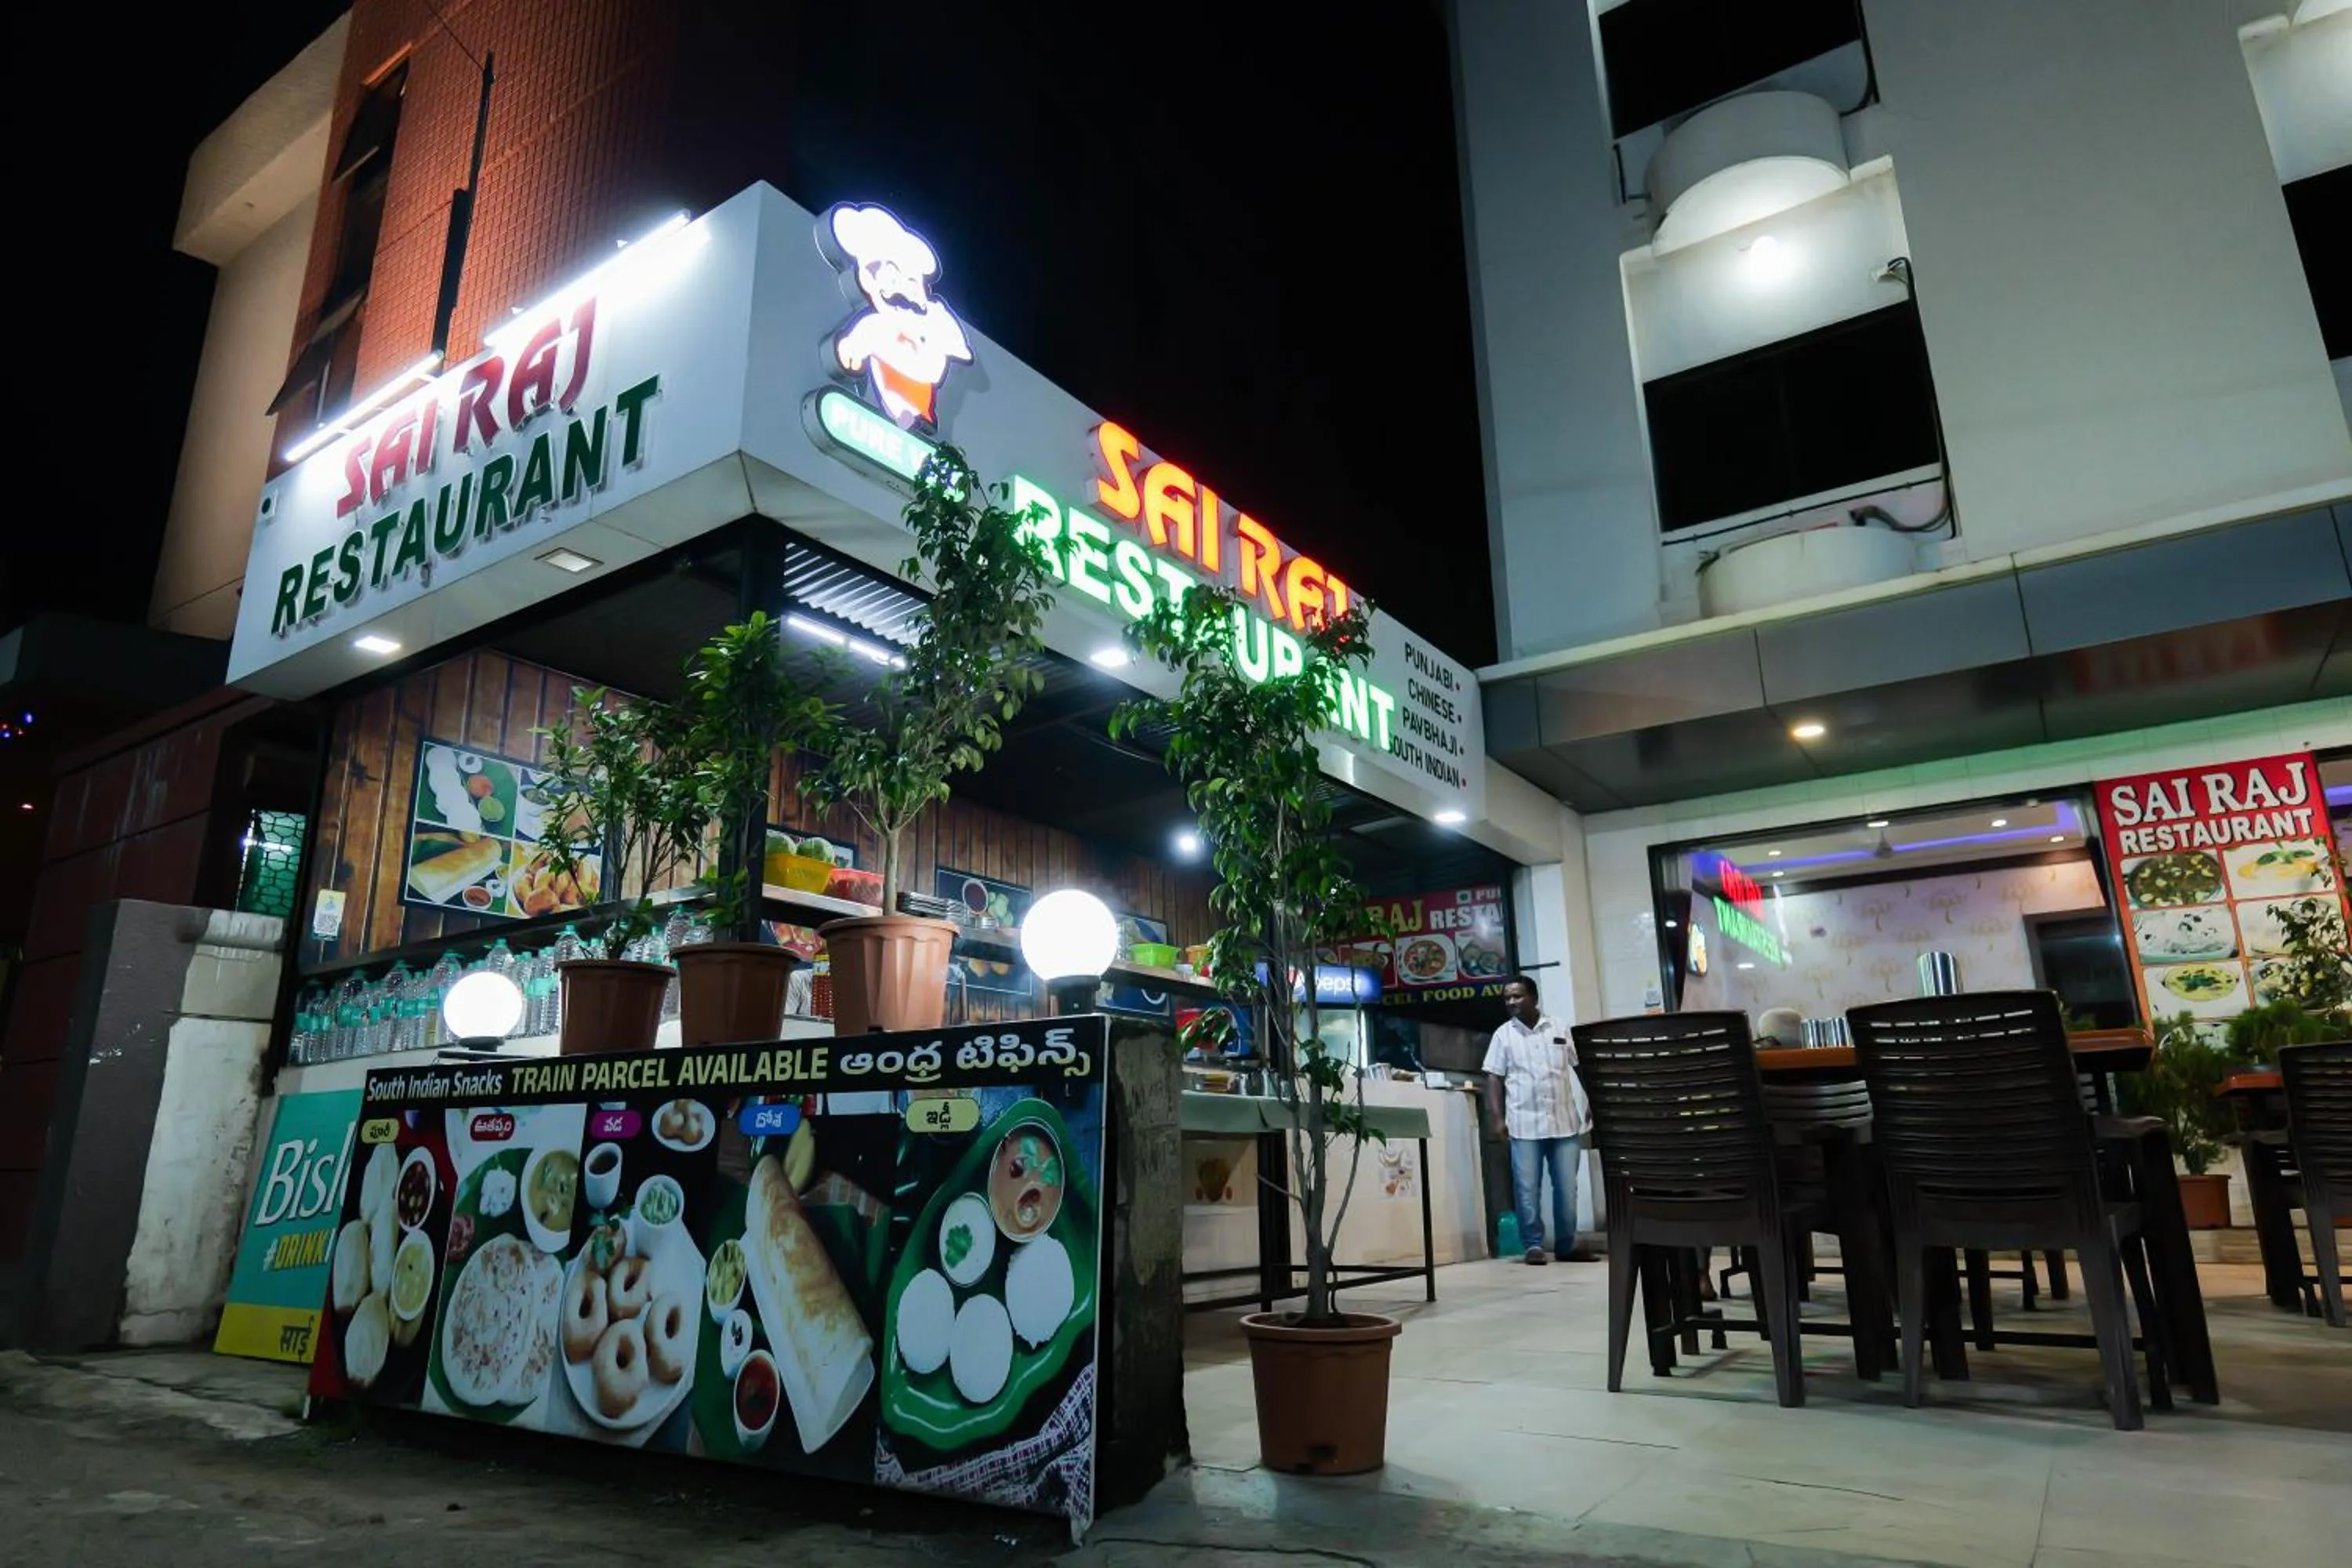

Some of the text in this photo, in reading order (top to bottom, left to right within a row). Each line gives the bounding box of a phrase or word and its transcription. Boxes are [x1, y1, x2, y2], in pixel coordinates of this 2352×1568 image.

[336, 295, 598, 518] SAI RAJ
[831, 401, 900, 459] PURE
[270, 373, 661, 636] RESTAURANT
[1096, 420, 1221, 573] SAI
[1014, 474, 1396, 752] RESTURNT
[1404, 641, 1454, 691] PUNJABI
[1407, 677, 1456, 724] CHINESE
[1402, 706, 1458, 757] PAVBHAJI
[1425, 752, 1461, 790] INDIAN
[2111, 761, 2309, 828] SAI RAJ
[2118, 807, 2314, 856] RESTAURANT
[1366, 899, 1423, 935] RAJ
[1422, 986, 1475, 1001] FOOD
[367, 1047, 829, 1101] South Indian Snacks TRAIN PARCEL AVAILABLE
[840, 1027, 1091, 1083] ఆంధ్ర టిఫిన్స్
